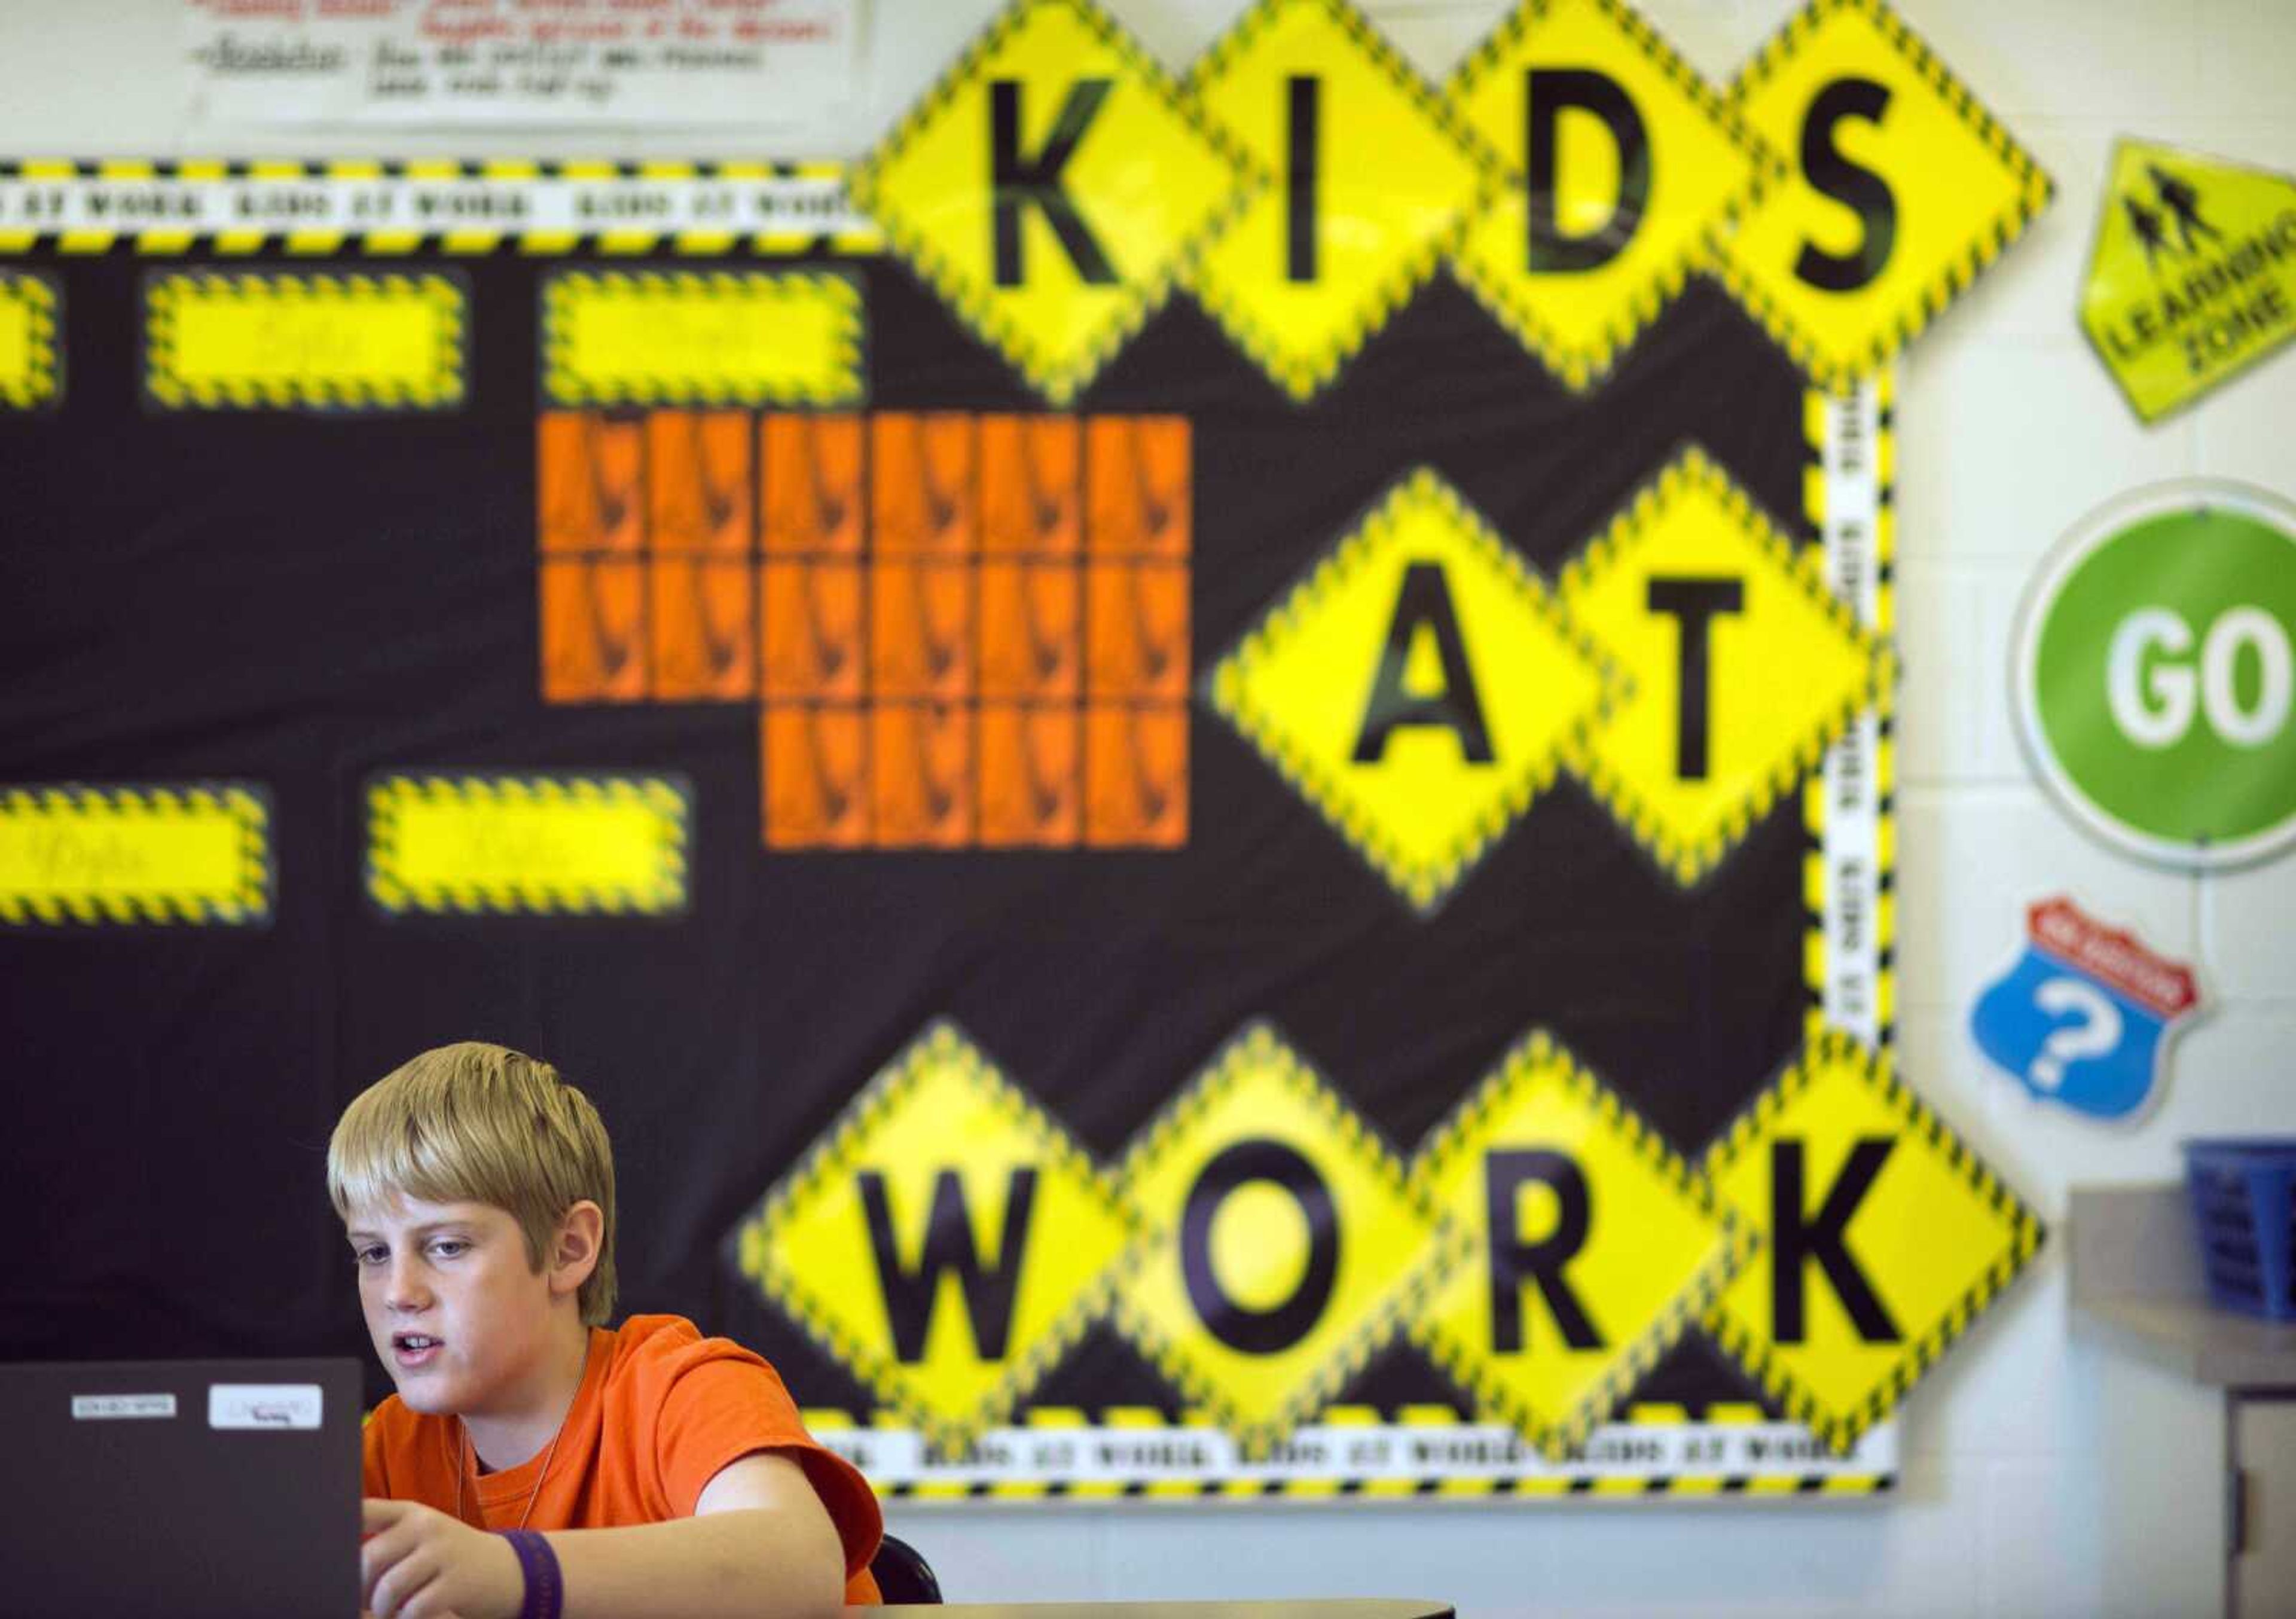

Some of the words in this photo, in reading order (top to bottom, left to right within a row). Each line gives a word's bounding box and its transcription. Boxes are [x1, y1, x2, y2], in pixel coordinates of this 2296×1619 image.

[989, 68, 1899, 293] KIDS
[2182, 283, 2289, 376] ZONE
[1350, 560, 1746, 780] AT
[2106, 605, 2294, 749] GO
[856, 1136, 1903, 1364] WORK
